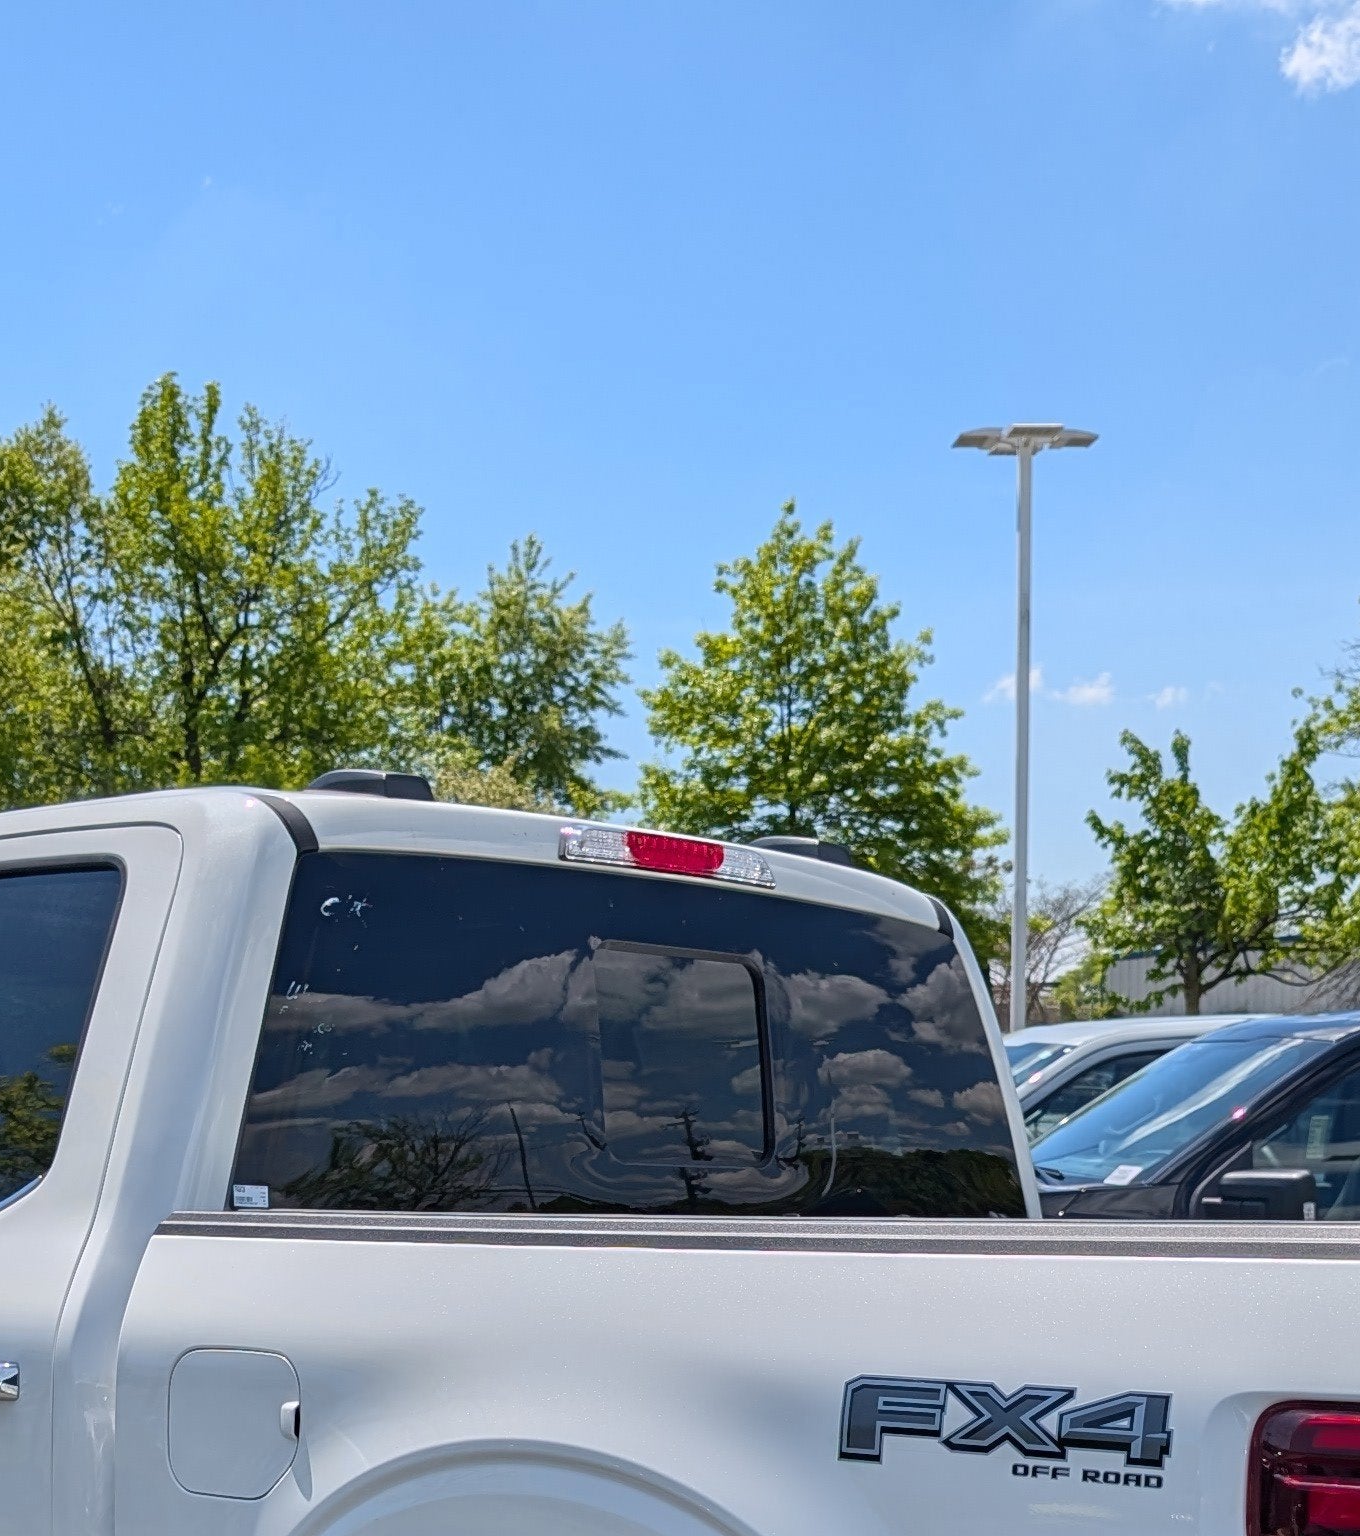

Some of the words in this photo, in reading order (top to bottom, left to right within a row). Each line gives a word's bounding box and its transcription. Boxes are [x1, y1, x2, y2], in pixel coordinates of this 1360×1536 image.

[838, 1373, 1174, 1470] FX4
[1011, 1463, 1071, 1480] OFF
[1081, 1468, 1164, 1489] ROAD
